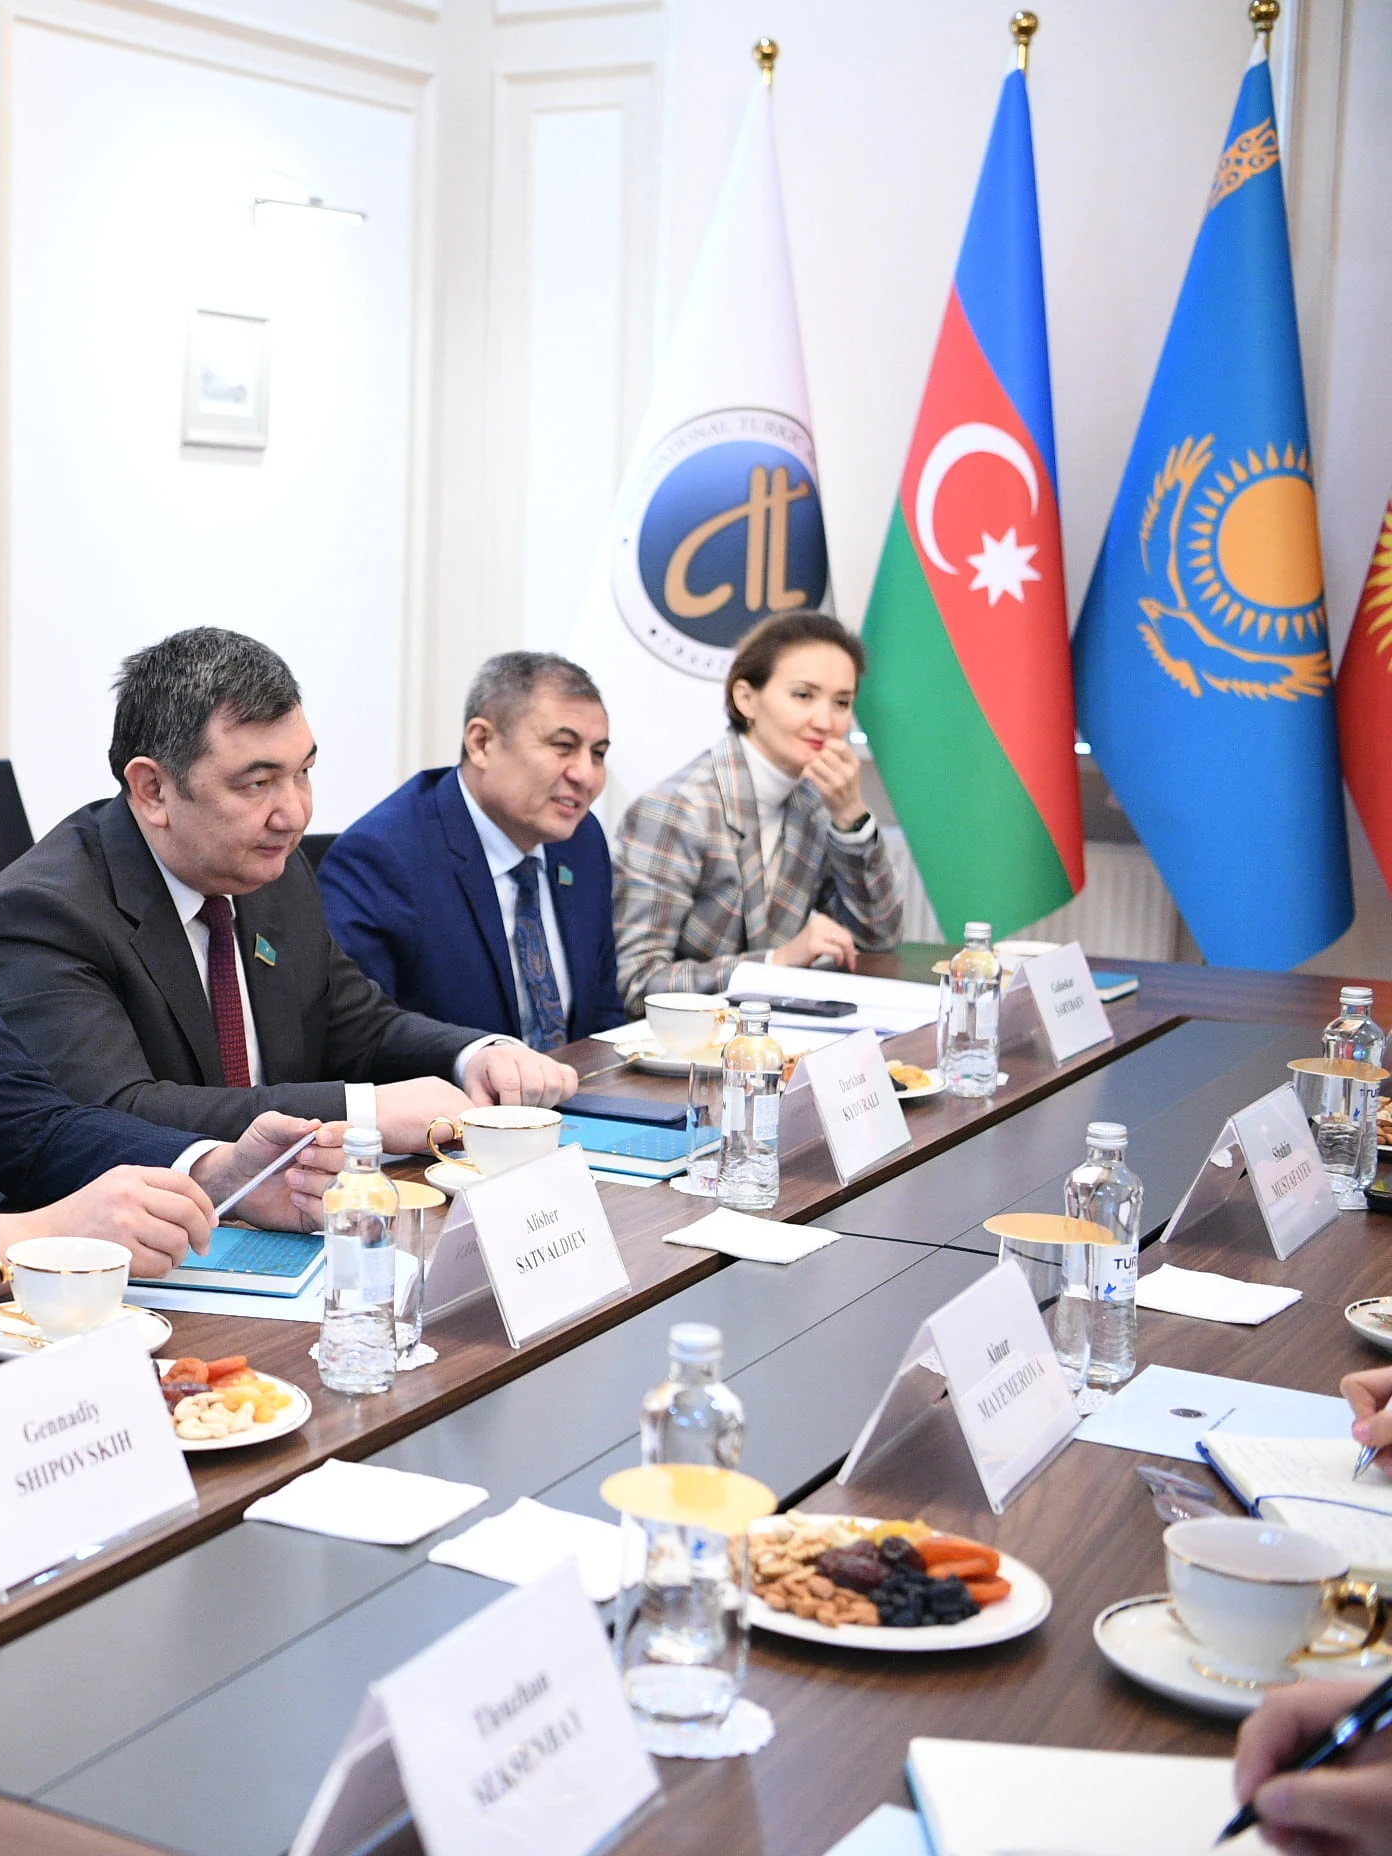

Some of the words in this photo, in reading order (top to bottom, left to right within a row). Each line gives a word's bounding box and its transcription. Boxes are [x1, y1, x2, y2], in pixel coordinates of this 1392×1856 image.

[527, 1210, 558, 1234] Alisher
[515, 1229, 586, 1274] SATVALDIEV
[22, 1400, 99, 1444] Gennadiy
[15, 1430, 133, 1494] SHIPOVSKIH
